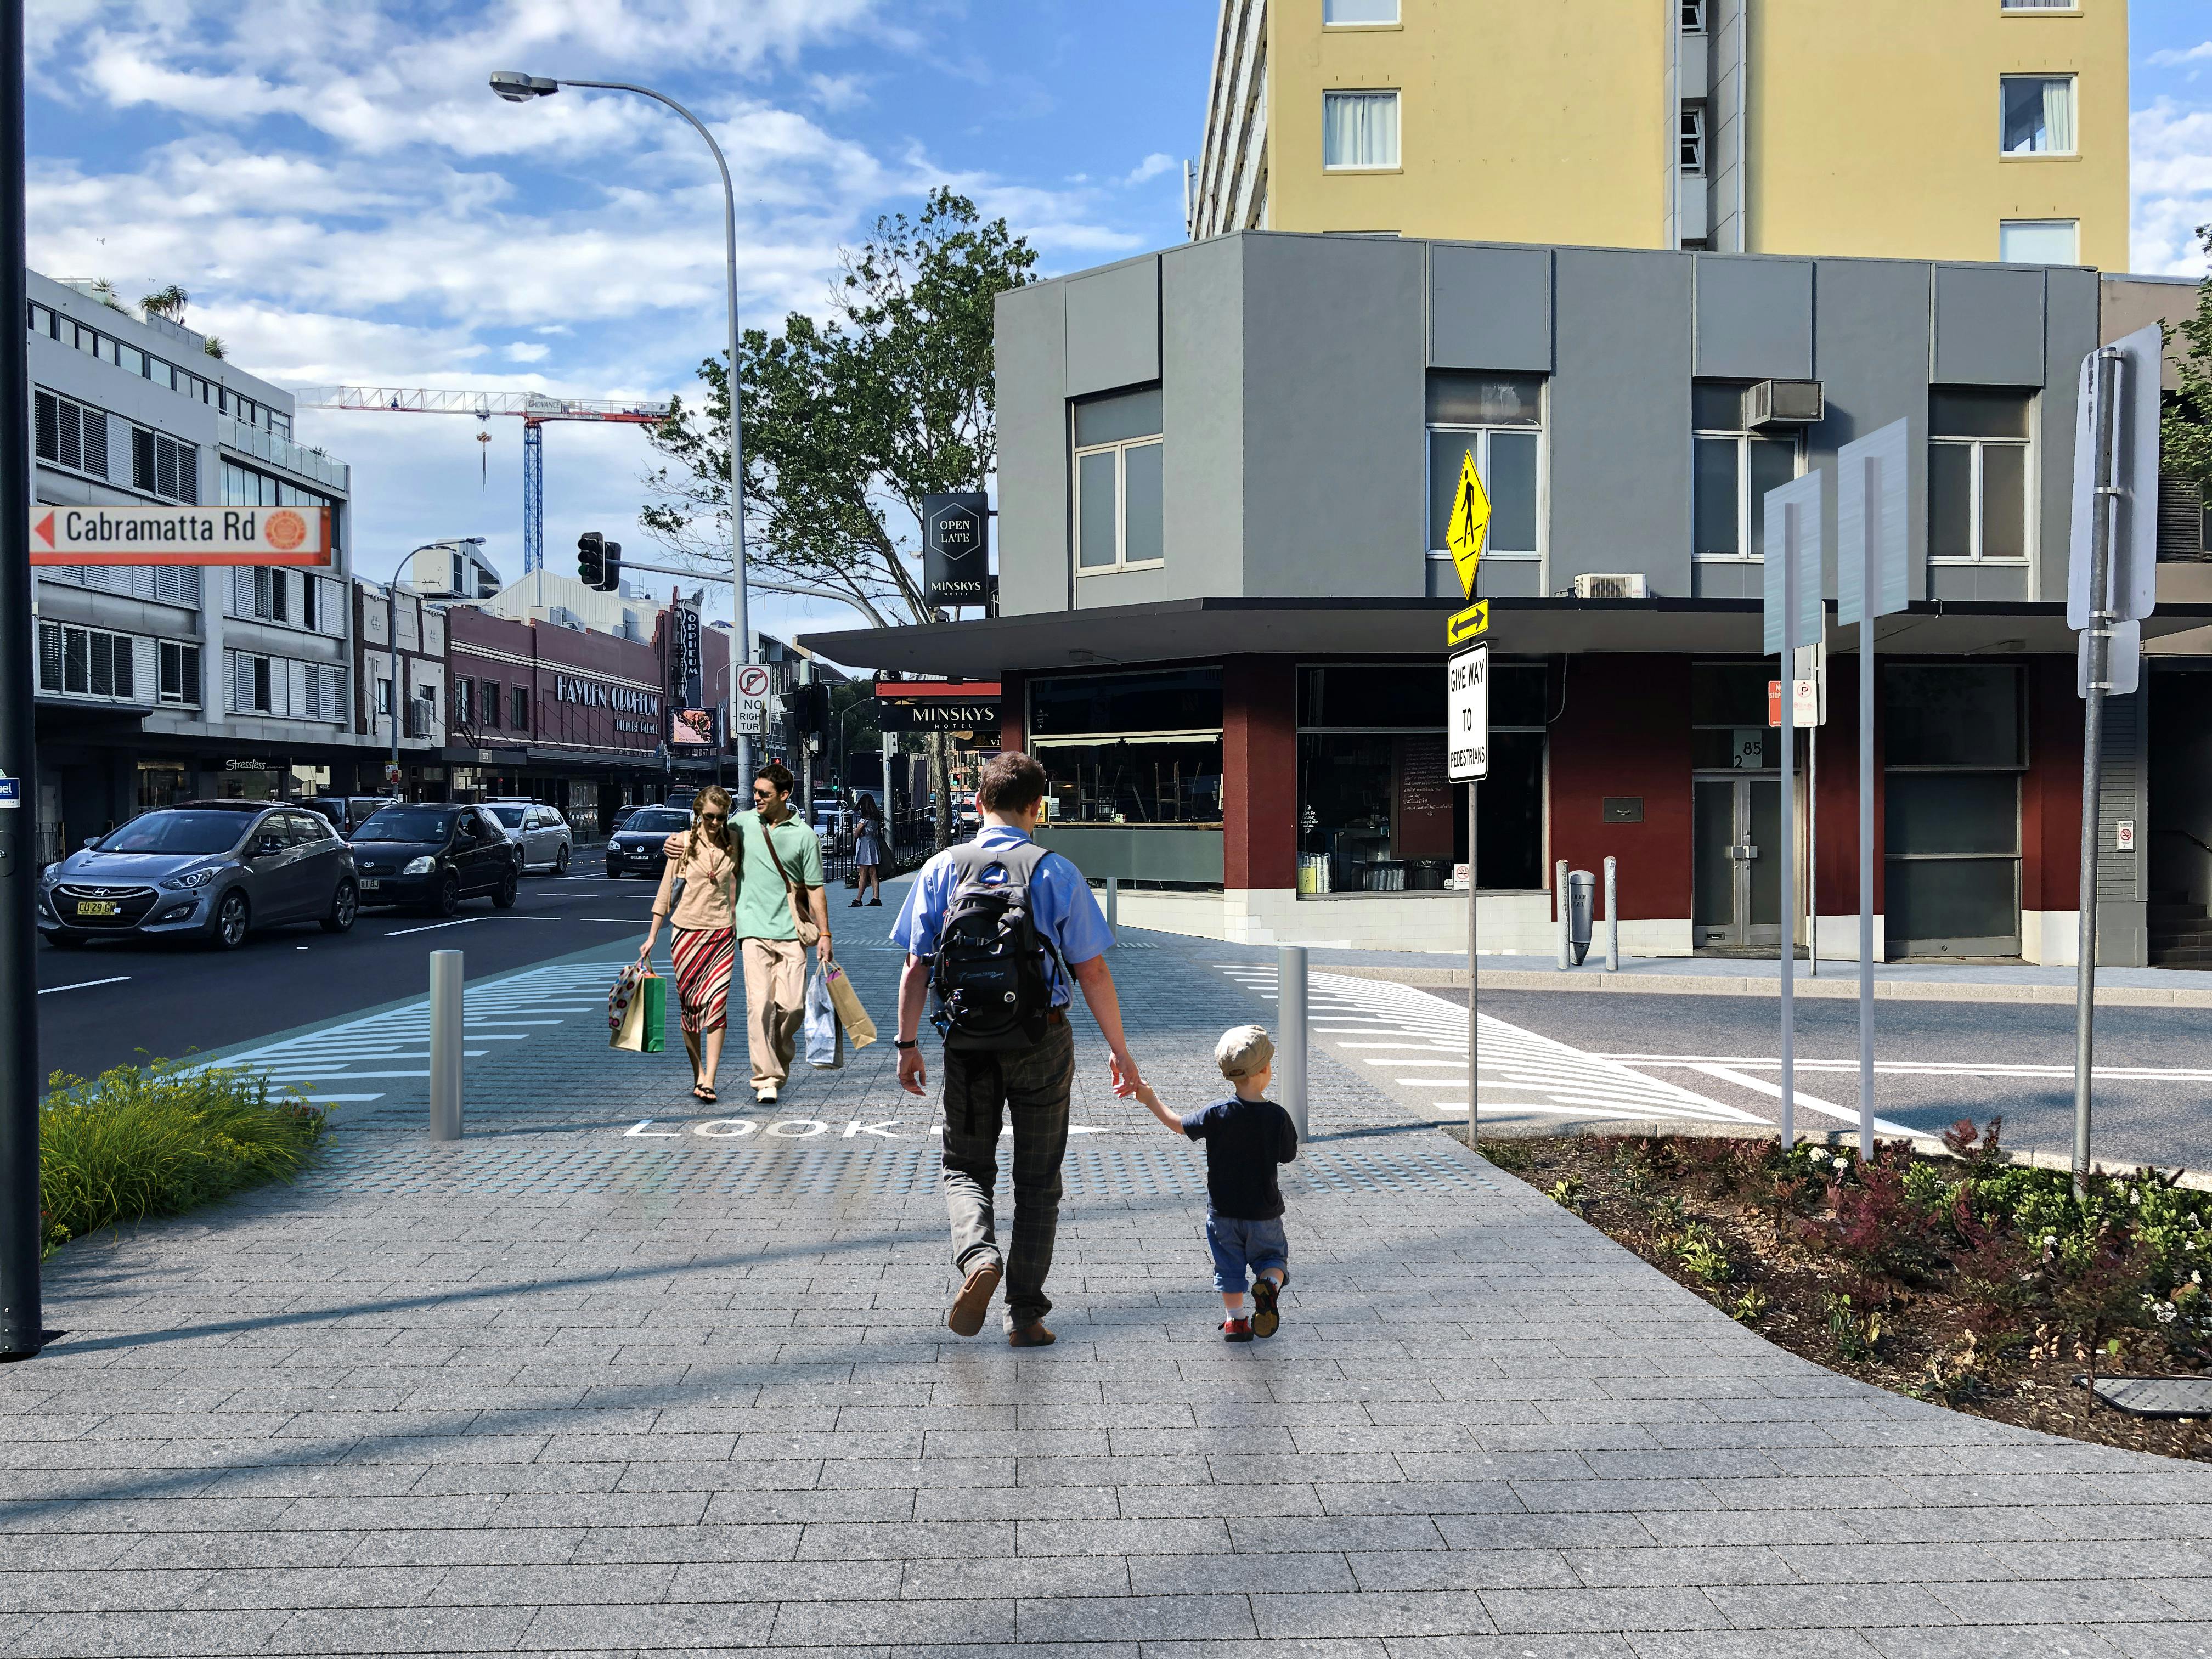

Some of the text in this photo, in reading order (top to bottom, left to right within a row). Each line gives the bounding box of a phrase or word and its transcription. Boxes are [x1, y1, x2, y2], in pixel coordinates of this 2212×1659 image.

[66, 511, 213, 542] Cabramatta
[224, 511, 256, 541] Rd
[940, 521, 970, 531] OPEN
[940, 533, 970, 543] LATE
[931, 582, 981, 591] MINSKYS
[687, 614, 698, 674] ORPHEUM
[1451, 658, 1485, 692] GIVE WAY
[557, 675, 658, 716] HAYDEN ORPHEUM
[744, 699, 763, 710] NO
[913, 707, 994, 721] MINSKYS
[1463, 708, 1472, 732] TO
[616, 719, 658, 735] PICTURE PALACE
[1743, 741, 1762, 755] 85
[1451, 746, 1485, 768] PEDESTRIANS
[1734, 755, 1743, 768] 2
[225, 759, 267, 771] Stressless
[92, 902, 103, 912] 29
[622, 1119, 902, 1138] LOOK
